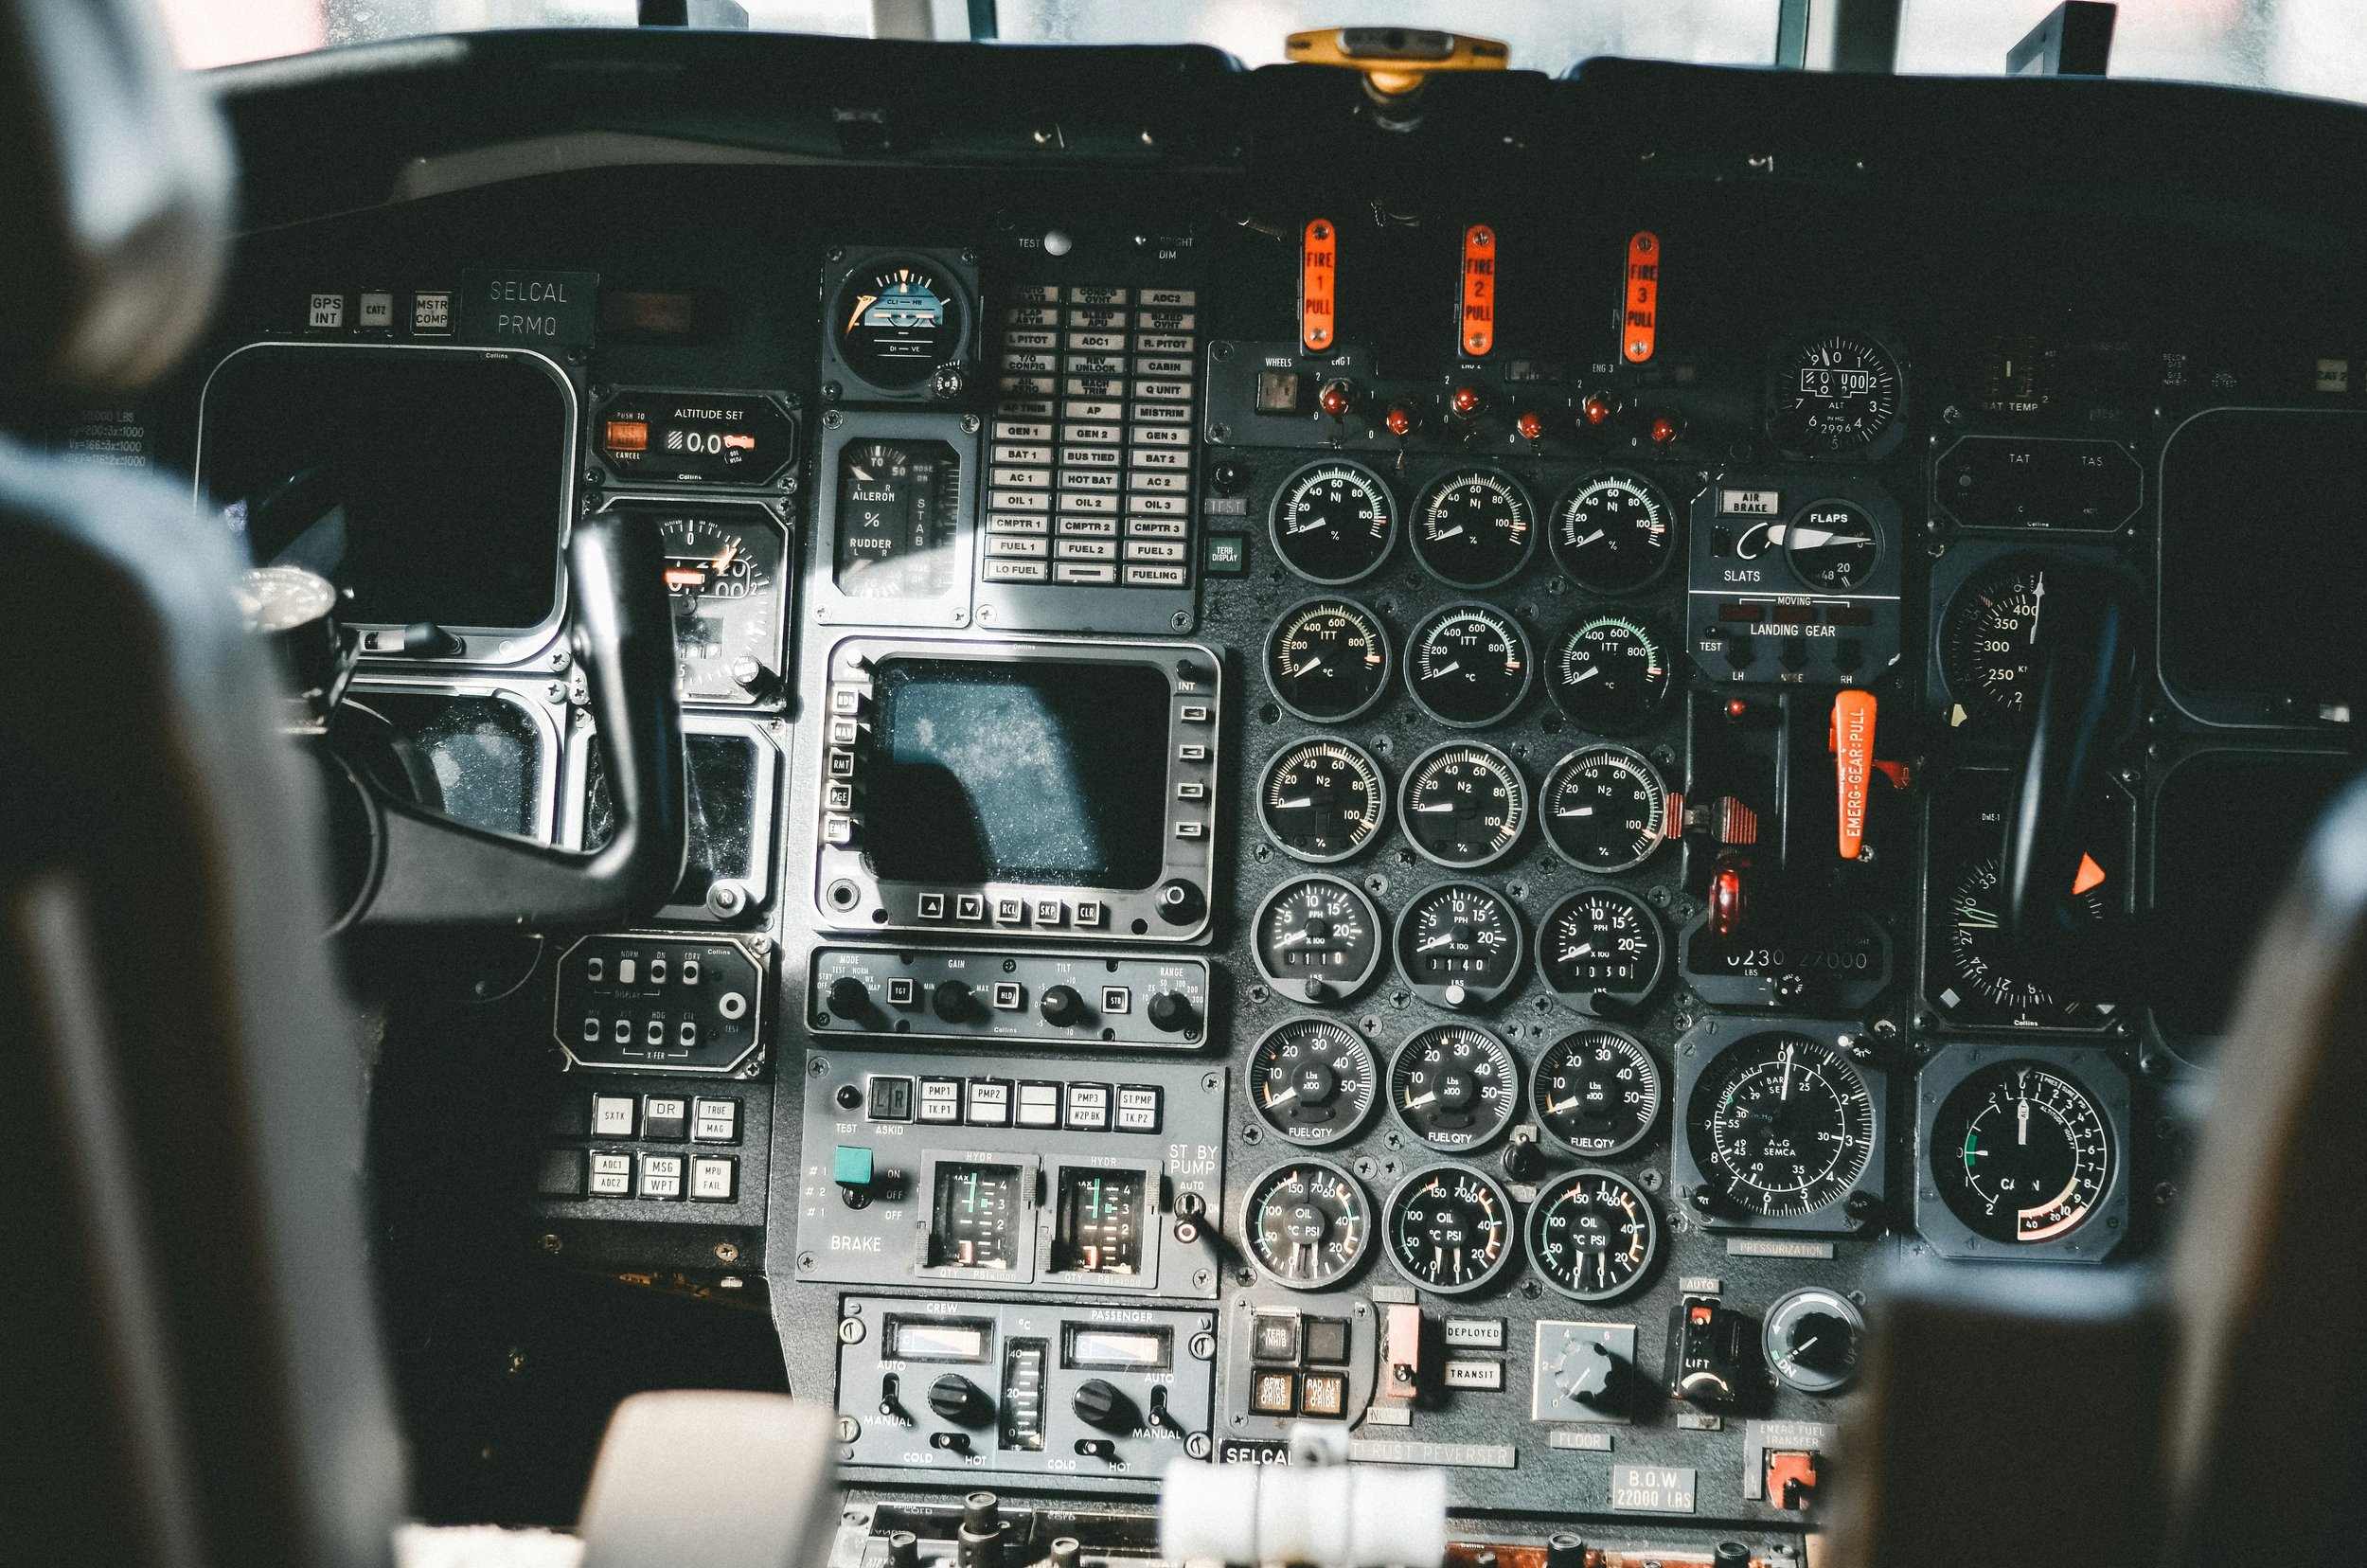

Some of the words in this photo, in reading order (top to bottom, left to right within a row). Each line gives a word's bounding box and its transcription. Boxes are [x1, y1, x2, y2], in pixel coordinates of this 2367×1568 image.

[1019, 238, 1041, 248] TEST
[1159, 250, 1177, 259] DIM
[1307, 252, 1333, 267] FIRE
[1468, 258, 1493, 276] FIRE
[1630, 264, 1657, 281] FIRE
[1317, 276, 1323, 291] 1
[490, 281, 568, 303] SELCAL
[1474, 281, 1485, 297] 2
[1153, 294, 1181, 303] ADC2
[1637, 287, 1647, 303] 3
[312, 298, 342, 310] GPS
[417, 300, 448, 310] MSTR
[1306, 299, 1331, 314] PULL
[315, 312, 337, 324] INT
[1466, 305, 1491, 321] PULL
[416, 314, 448, 324] COMP
[1628, 311, 1653, 328] PULL
[498, 314, 557, 336] PRMQ
[1082, 337, 1110, 346] ADC1
[486, 351, 508, 360] Collins
[1148, 363, 1181, 371] CABIN
[1266, 357, 1291, 367] WHEELS
[1147, 386, 1154, 395] Q
[1157, 386, 1181, 395] UNIT
[2009, 402, 2038, 411] TEMP
[674, 408, 721, 419] ALTITUDE
[725, 410, 743, 420] SET
[1140, 408, 1184, 418] MISTRIM
[1008, 427, 1031, 436] GEN
[1822, 423, 1851, 435] 2996
[1147, 432, 1168, 440] GEN
[615, 452, 641, 460] CANCEL
[2009, 454, 2031, 463] TAT
[2082, 456, 2103, 466] TAS
[1068, 475, 1089, 484] HOT
[1092, 476, 1112, 485] BAT
[853, 491, 895, 502] AILERON
[1742, 493, 1760, 502] AIR
[1734, 504, 1768, 512] BRAKE
[1811, 514, 1847, 523] FLAPS
[1065, 522, 1101, 530] CMPTR
[1134, 524, 1170, 532] CMPTR
[850, 538, 892, 549] RUDDER
[1069, 544, 1095, 553] FUEL
[1138, 546, 1164, 555] FUEL
[1132, 570, 1177, 579] FUELING
[1724, 571, 1761, 581] SLATS
[1777, 597, 1811, 606] MOVING
[1994, 618, 2019, 630] 350
[1751, 624, 1799, 635] LANDING
[1806, 626, 1836, 636] GEAR
[1321, 632, 1337, 640] ITT
[1460, 636, 1477, 646] ITT
[1601, 642, 1619, 651] ITT
[1700, 642, 1722, 650] TEST
[1984, 641, 2010, 652] 300
[1733, 671, 1744, 681] LH
[1841, 675, 1852, 684] RH
[1988, 669, 2014, 680] 250
[1178, 682, 1195, 691] INT
[834, 759, 849, 770] RMT
[1003, 903, 1016, 914] RCL
[1041, 905, 1056, 916] SKP
[1080, 907, 1094, 918] CLR
[840, 955, 859, 965] MODE
[948, 960, 966, 970] GAIN
[1057, 963, 1071, 972] TILT
[1160, 968, 1184, 977] RANGE
[896, 987, 906, 995] TGT
[1001, 991, 1012, 1000] HLD
[1111, 996, 1121, 1005] STB
[929, 1087, 951, 1096] PMP1
[978, 1090, 1000, 1098] PMP2
[1077, 1093, 1098, 1102] PMP3
[1123, 1095, 1152, 1105] ST.PMP
[656, 1103, 675, 1114] DR
[707, 1106, 725, 1114] TRUE
[1126, 1114, 1148, 1123] TK.P2
[706, 1124, 724, 1133] MAG
[836, 1123, 858, 1132] TEST
[876, 1126, 903, 1135] ASKID
[1290, 1128, 1310, 1137] FUEL
[1311, 1128, 1332, 1138] QTY
[1428, 1132, 1449, 1143] FUEL
[1450, 1133, 1472, 1144] QTY
[1571, 1137, 1593, 1148] FUEL
[1593, 1138, 1614, 1149] QTY
[1170, 1144, 1187, 1159] ST
[1197, 1145, 1218, 1160] BY
[1764, 1148, 1796, 1157] SEMCA
[652, 1162, 673, 1172] MSG
[1091, 1157, 1116, 1167] HYDR
[705, 1167, 721, 1175] MPU
[1170, 1160, 1215, 1175] PUMP
[650, 1181, 672, 1191] WPT
[703, 1181, 721, 1189] FAIL
[1180, 1181, 1204, 1190] AUTO
[1295, 1208, 1312, 1219] OIL
[1436, 1212, 1452, 1223] OIL
[1580, 1217, 1597, 1228] OIL
[1305, 1226, 1320, 1237] PSI
[831, 1235, 881, 1252] BRAKE
[1739, 1242, 1824, 1256] PRESSURIZATION
[1686, 1280, 1714, 1290] AUTO
[926, 1303, 958, 1313] CREW
[1091, 1310, 1153, 1323] PASSENGER
[1448, 1327, 1499, 1338] DEPLOYED
[877, 1361, 906, 1371] AUTO
[1685, 1358, 1710, 1369] LIFT
[1145, 1374, 1174, 1383] AUTO
[1450, 1369, 1494, 1380] TRANSIT
[1263, 1378, 1285, 1387] GPWS
[1263, 1387, 1285, 1397] VOICE
[863, 1416, 912, 1427] MANUAL
[1132, 1429, 1181, 1439] MANUAL
[1559, 1435, 1601, 1448] FLOOR
[903, 1452, 933, 1463] COLD
[965, 1455, 987, 1466] HOT
[1047, 1460, 1077, 1470] COLD
[1109, 1462, 1131, 1472] HOT
[1629, 1470, 1681, 1488] B.O.W.
[1617, 1489, 1659, 1506] 22000
[1667, 1492, 1692, 1508] LBS
